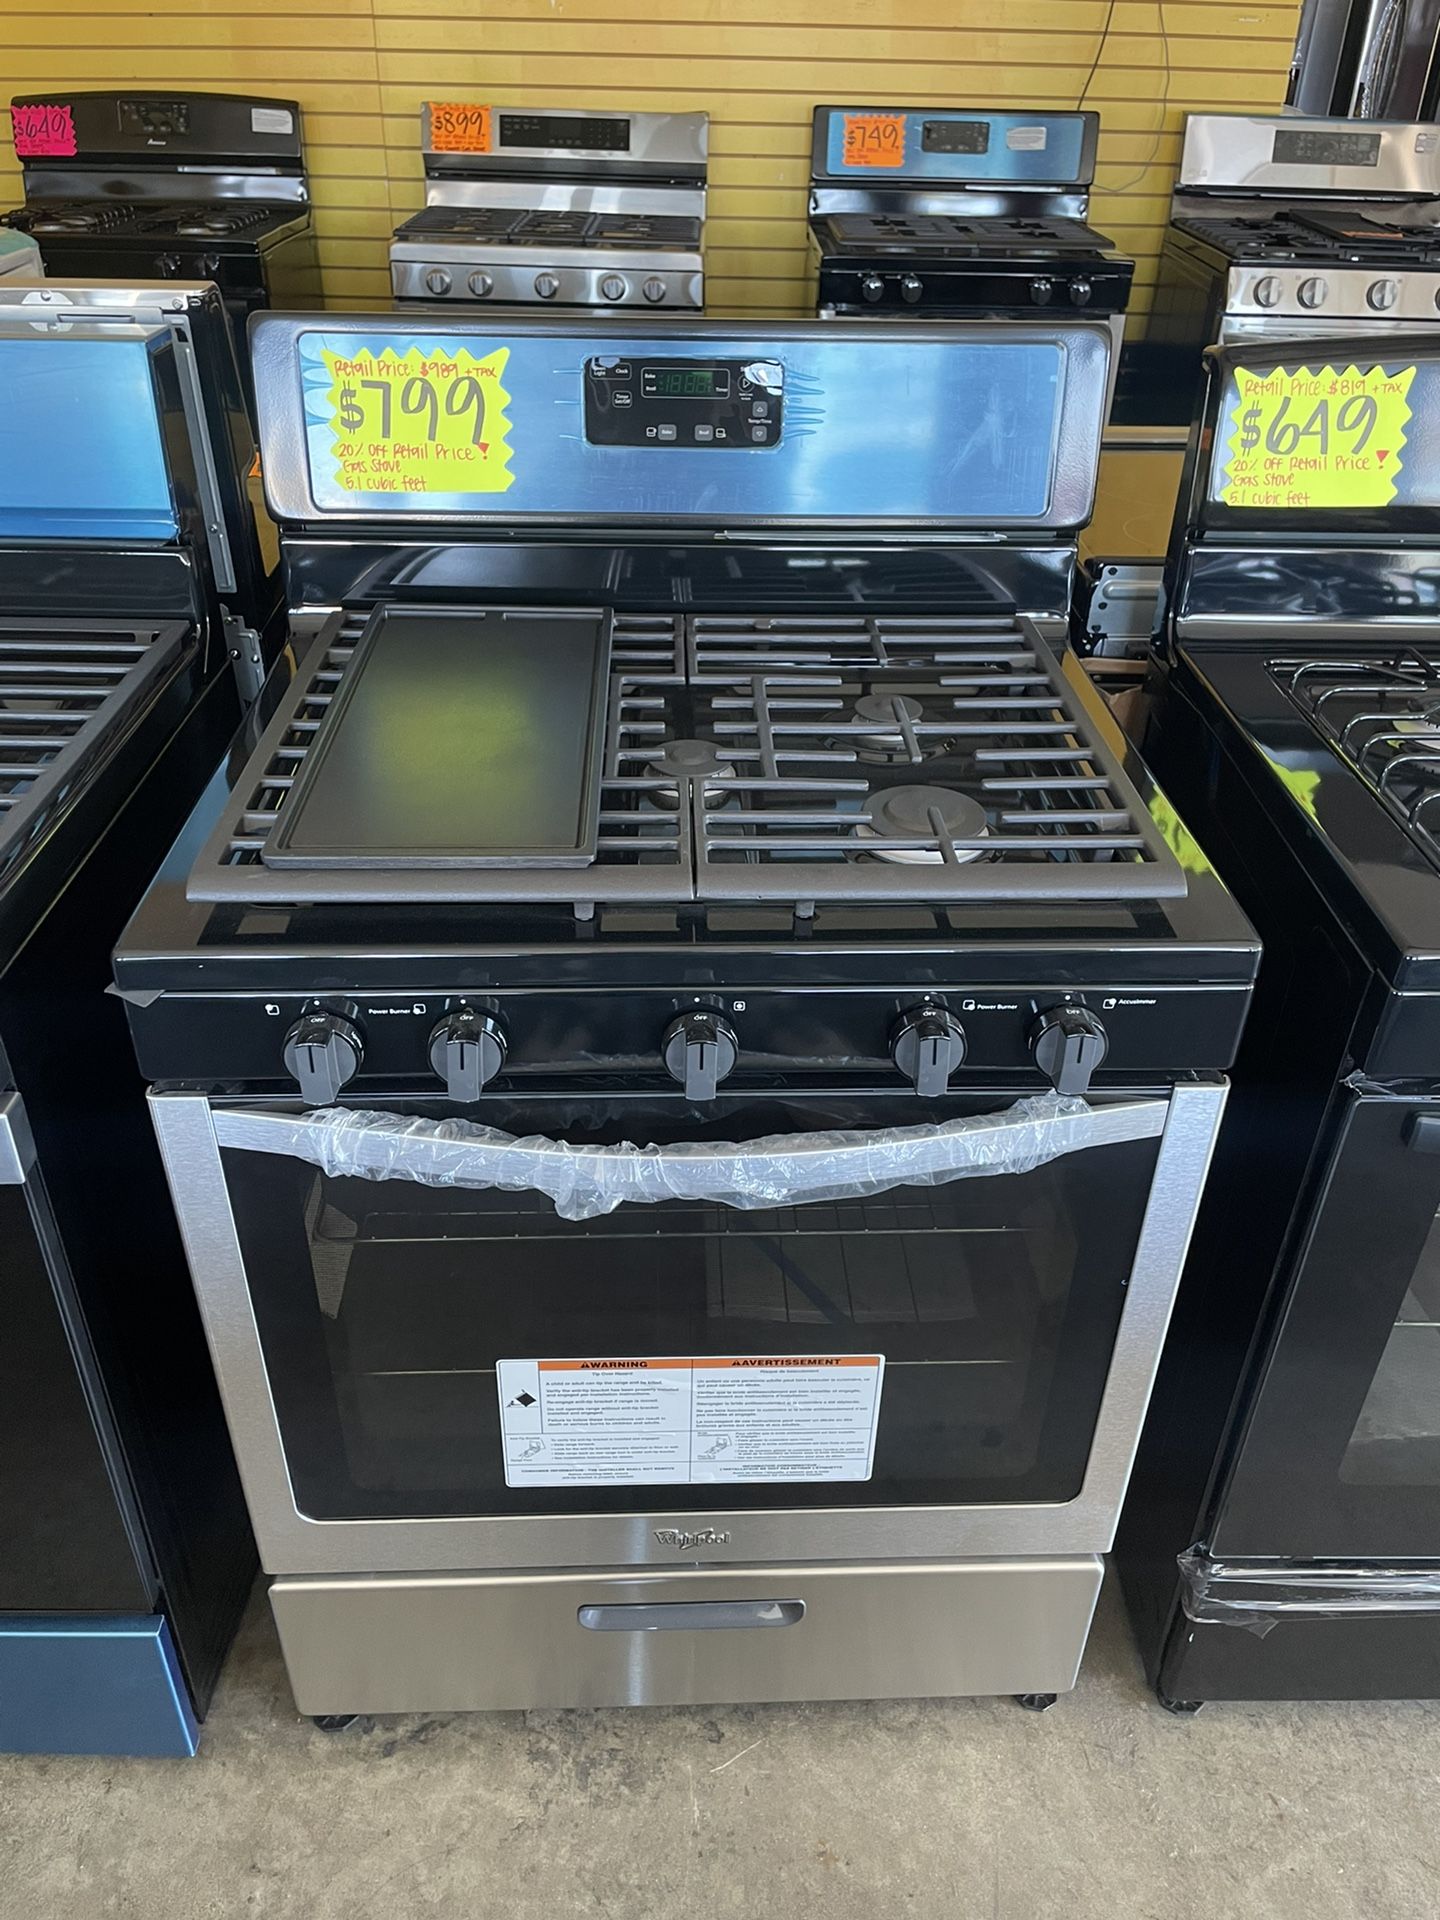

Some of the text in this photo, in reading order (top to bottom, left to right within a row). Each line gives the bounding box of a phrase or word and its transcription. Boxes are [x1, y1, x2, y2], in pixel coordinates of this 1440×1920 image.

[17, 112, 67, 139] $649
[435, 111, 483, 135] $899
[847, 124, 898, 148] $749
[334, 360, 373, 377] Retail
[1245, 378, 1283, 396] Retail
[1327, 379, 1366, 395] $819
[340, 377, 486, 445] $799
[1240, 394, 1378, 457] $649
[338, 442, 364, 457] 20%
[393, 442, 428, 459] Retail
[343, 458, 402, 473] Gas Stove
[1233, 458, 1258, 472] 20%
[1289, 456, 1328, 471] Retail
[345, 475, 427, 491] 5.1 cubic feet
[1233, 472, 1294, 487] Gas Stove
[1230, 489, 1311, 507] 5.1 cubic feet
[742, 1358, 841, 1366] AVERTISSEMENT
